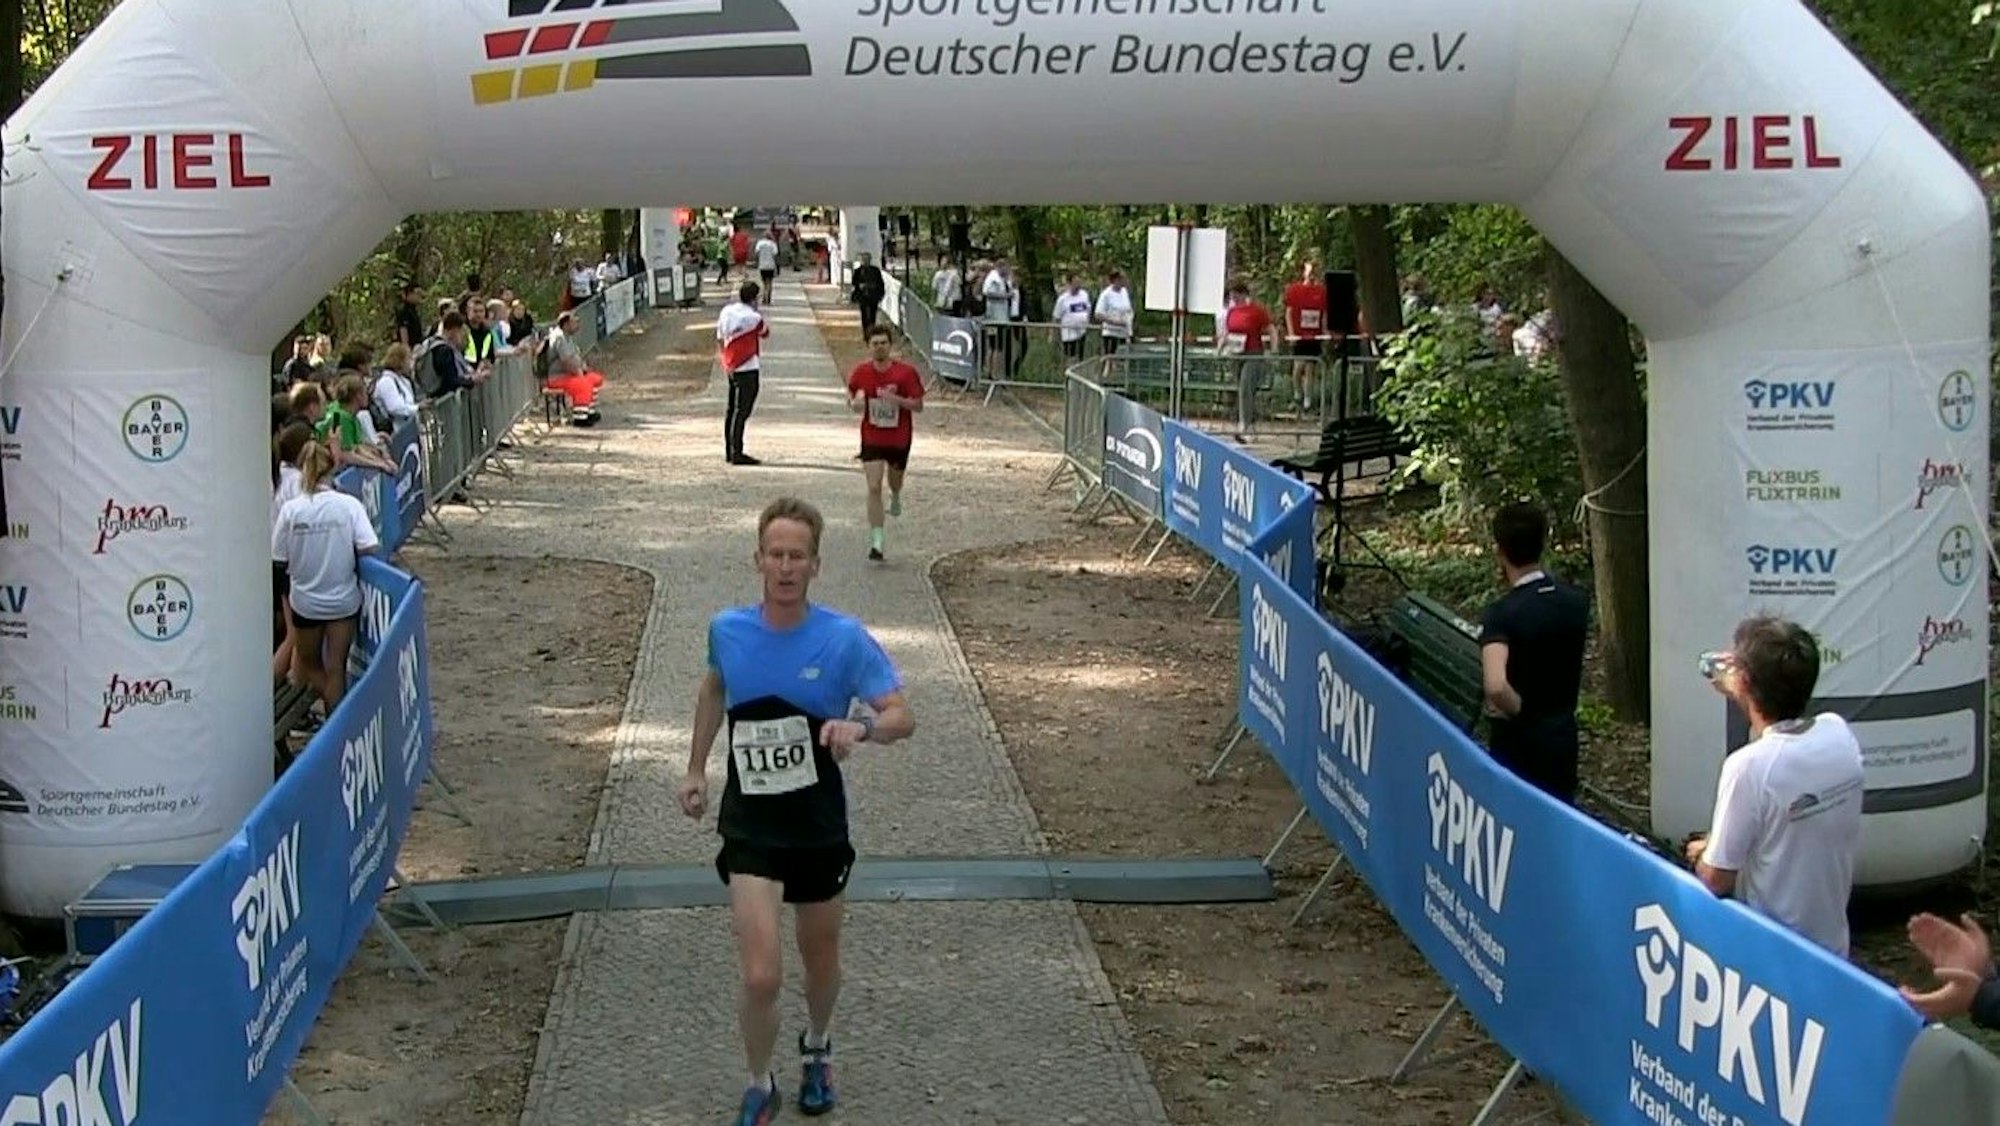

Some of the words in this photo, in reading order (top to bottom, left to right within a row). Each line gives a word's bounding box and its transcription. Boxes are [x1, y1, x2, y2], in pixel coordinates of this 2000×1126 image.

[845, 32, 1096, 76] Deutscher
[1110, 31, 1371, 84] Bundestag
[1388, 32, 1468, 73] e.V.
[88, 134, 271, 190] ZIEL
[1664, 115, 1841, 170] ZIEL
[1770, 381, 1835, 408] PKV
[128, 421, 183, 436] BAYER
[1773, 548, 1837, 574] PKV
[133, 601, 188, 616] BAYER
[1260, 599, 1288, 683] PKV
[1330, 671, 1375, 777] PKV
[354, 705, 384, 819] PKV
[743, 744, 805, 771] 1160
[37, 803, 103, 816] Deutscher
[107, 800, 177, 815] Bundestag
[41, 784, 166, 804] Sportgemeinschaft
[1447, 779, 1515, 915] PKV
[257, 820, 300, 968] PKV
[1678, 940, 1825, 1126] PKV
[42, 997, 142, 1126] PKV
[1631, 1039, 1696, 1112] Verband
[1698, 1092, 1728, 1126] der
[1630, 1076, 1692, 1126] Kranke
